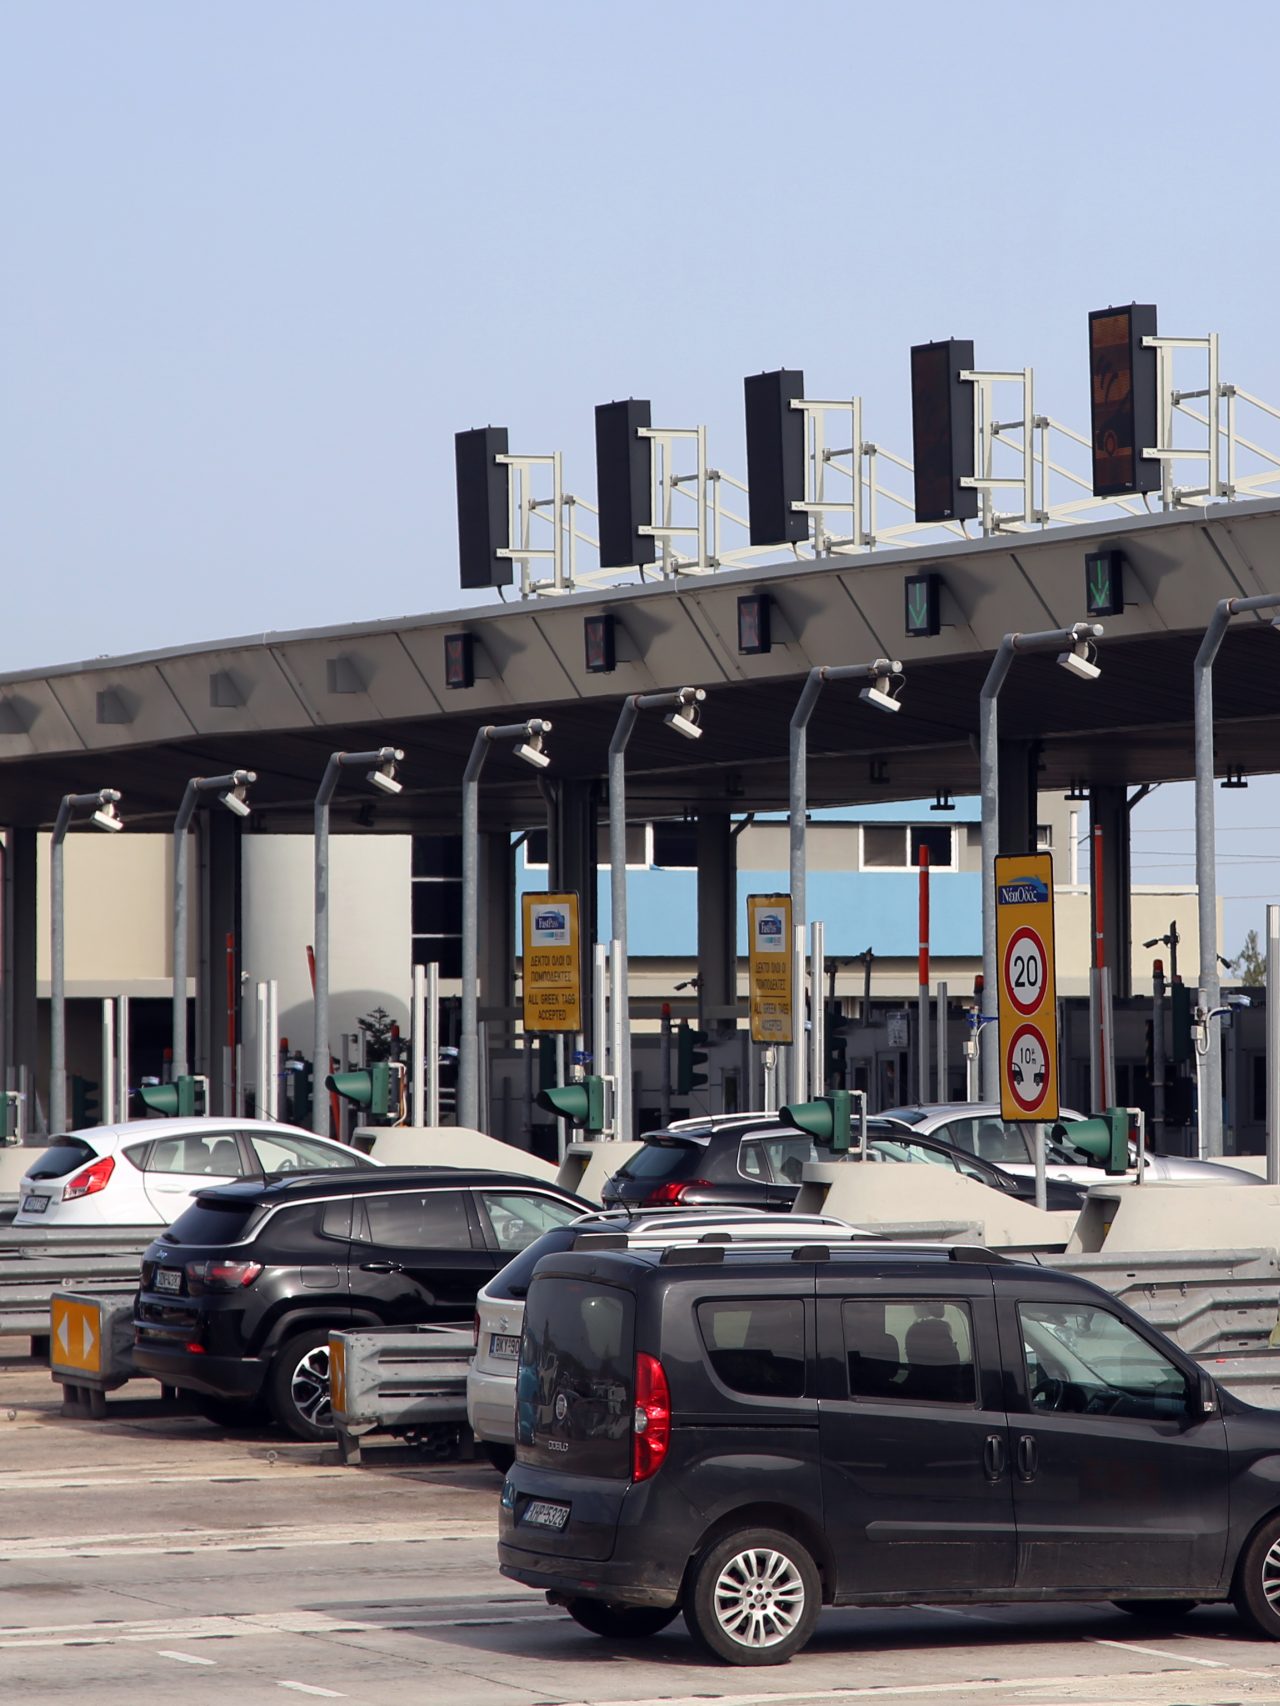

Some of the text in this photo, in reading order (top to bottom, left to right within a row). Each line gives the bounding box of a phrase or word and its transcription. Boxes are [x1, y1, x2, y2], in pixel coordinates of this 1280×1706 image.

[1014, 955, 1039, 988] 20
[528, 994, 576, 1005] ALL GREEK TAGS
[538, 1009, 567, 1021] ACCEPTED
[1020, 1047, 1031, 1064] 10
